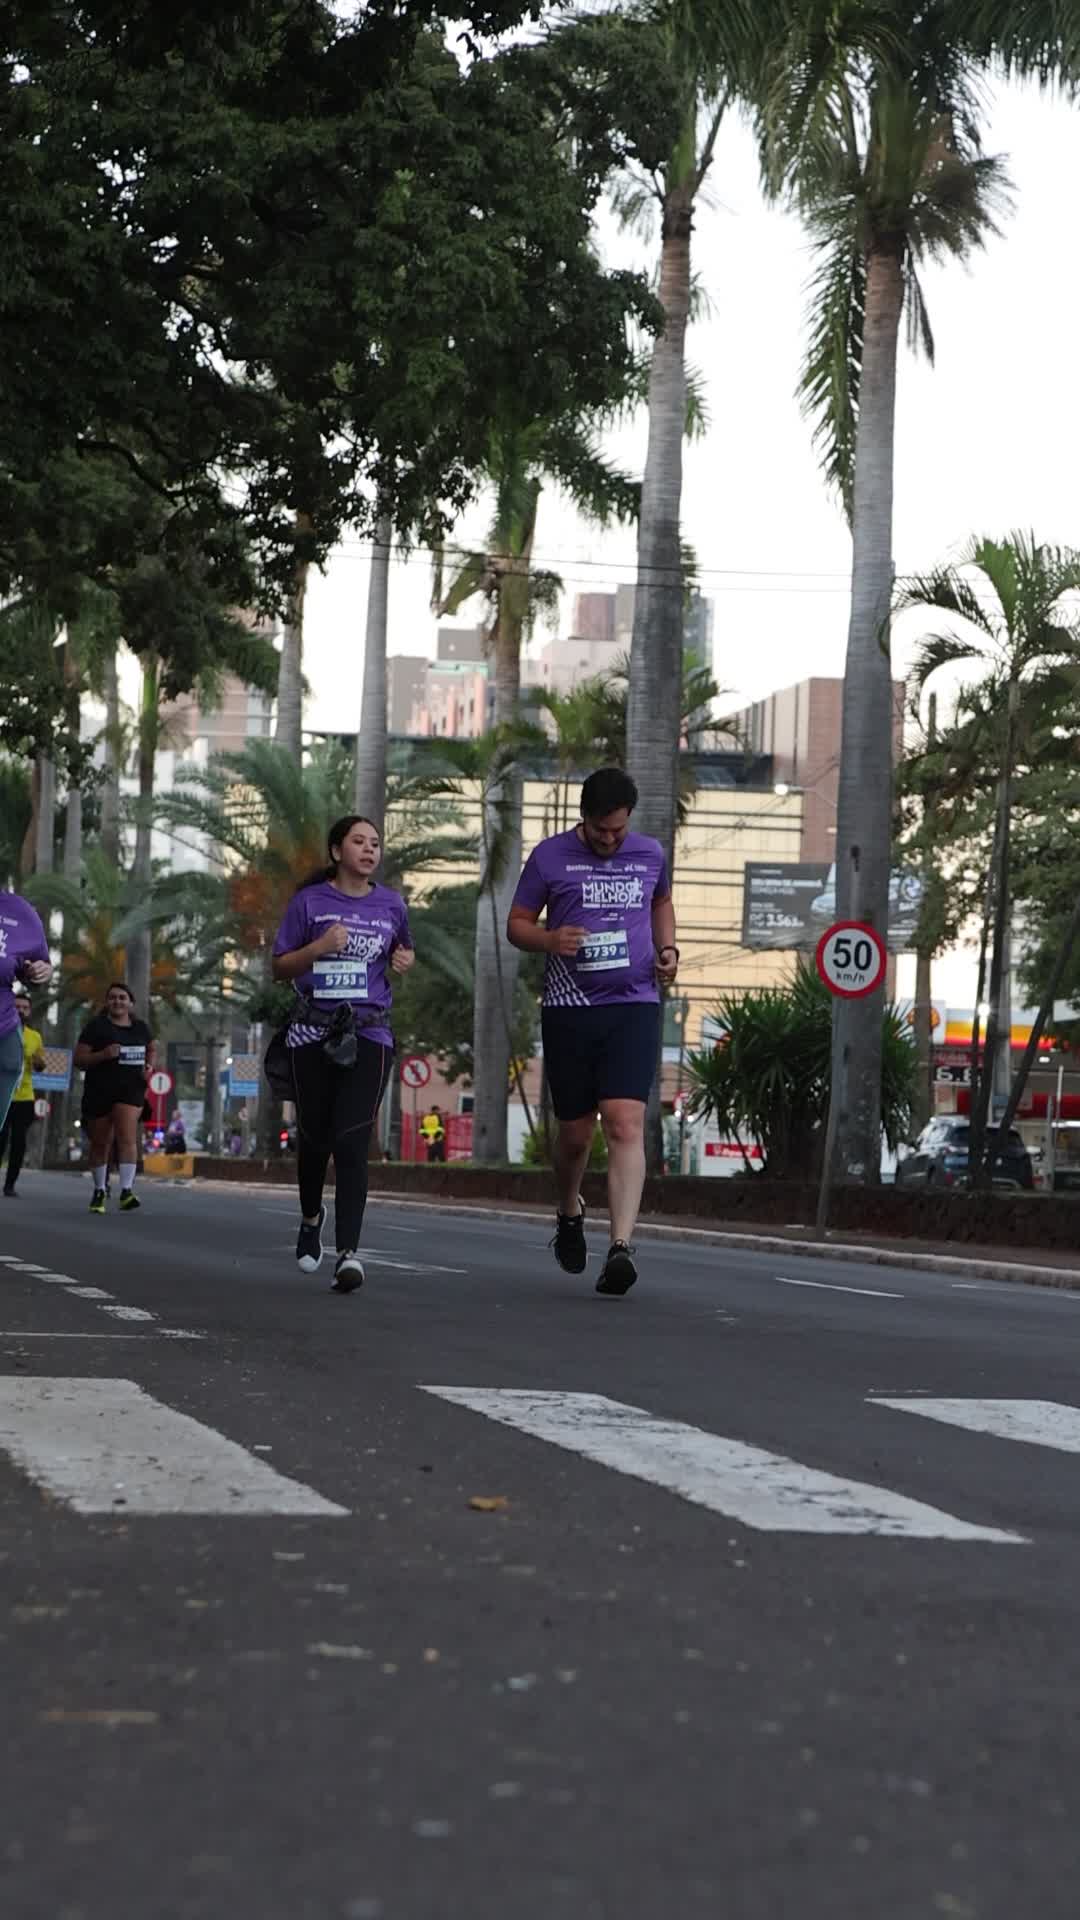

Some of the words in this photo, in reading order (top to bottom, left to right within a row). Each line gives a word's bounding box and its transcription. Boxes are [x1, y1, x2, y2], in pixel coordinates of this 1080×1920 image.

[582, 882, 635, 893] MUNDO
[582, 892, 643, 903] MELHOR
[584, 945, 617, 959] 5739
[832, 938, 873, 971] 50
[836, 971, 865, 983] km/h
